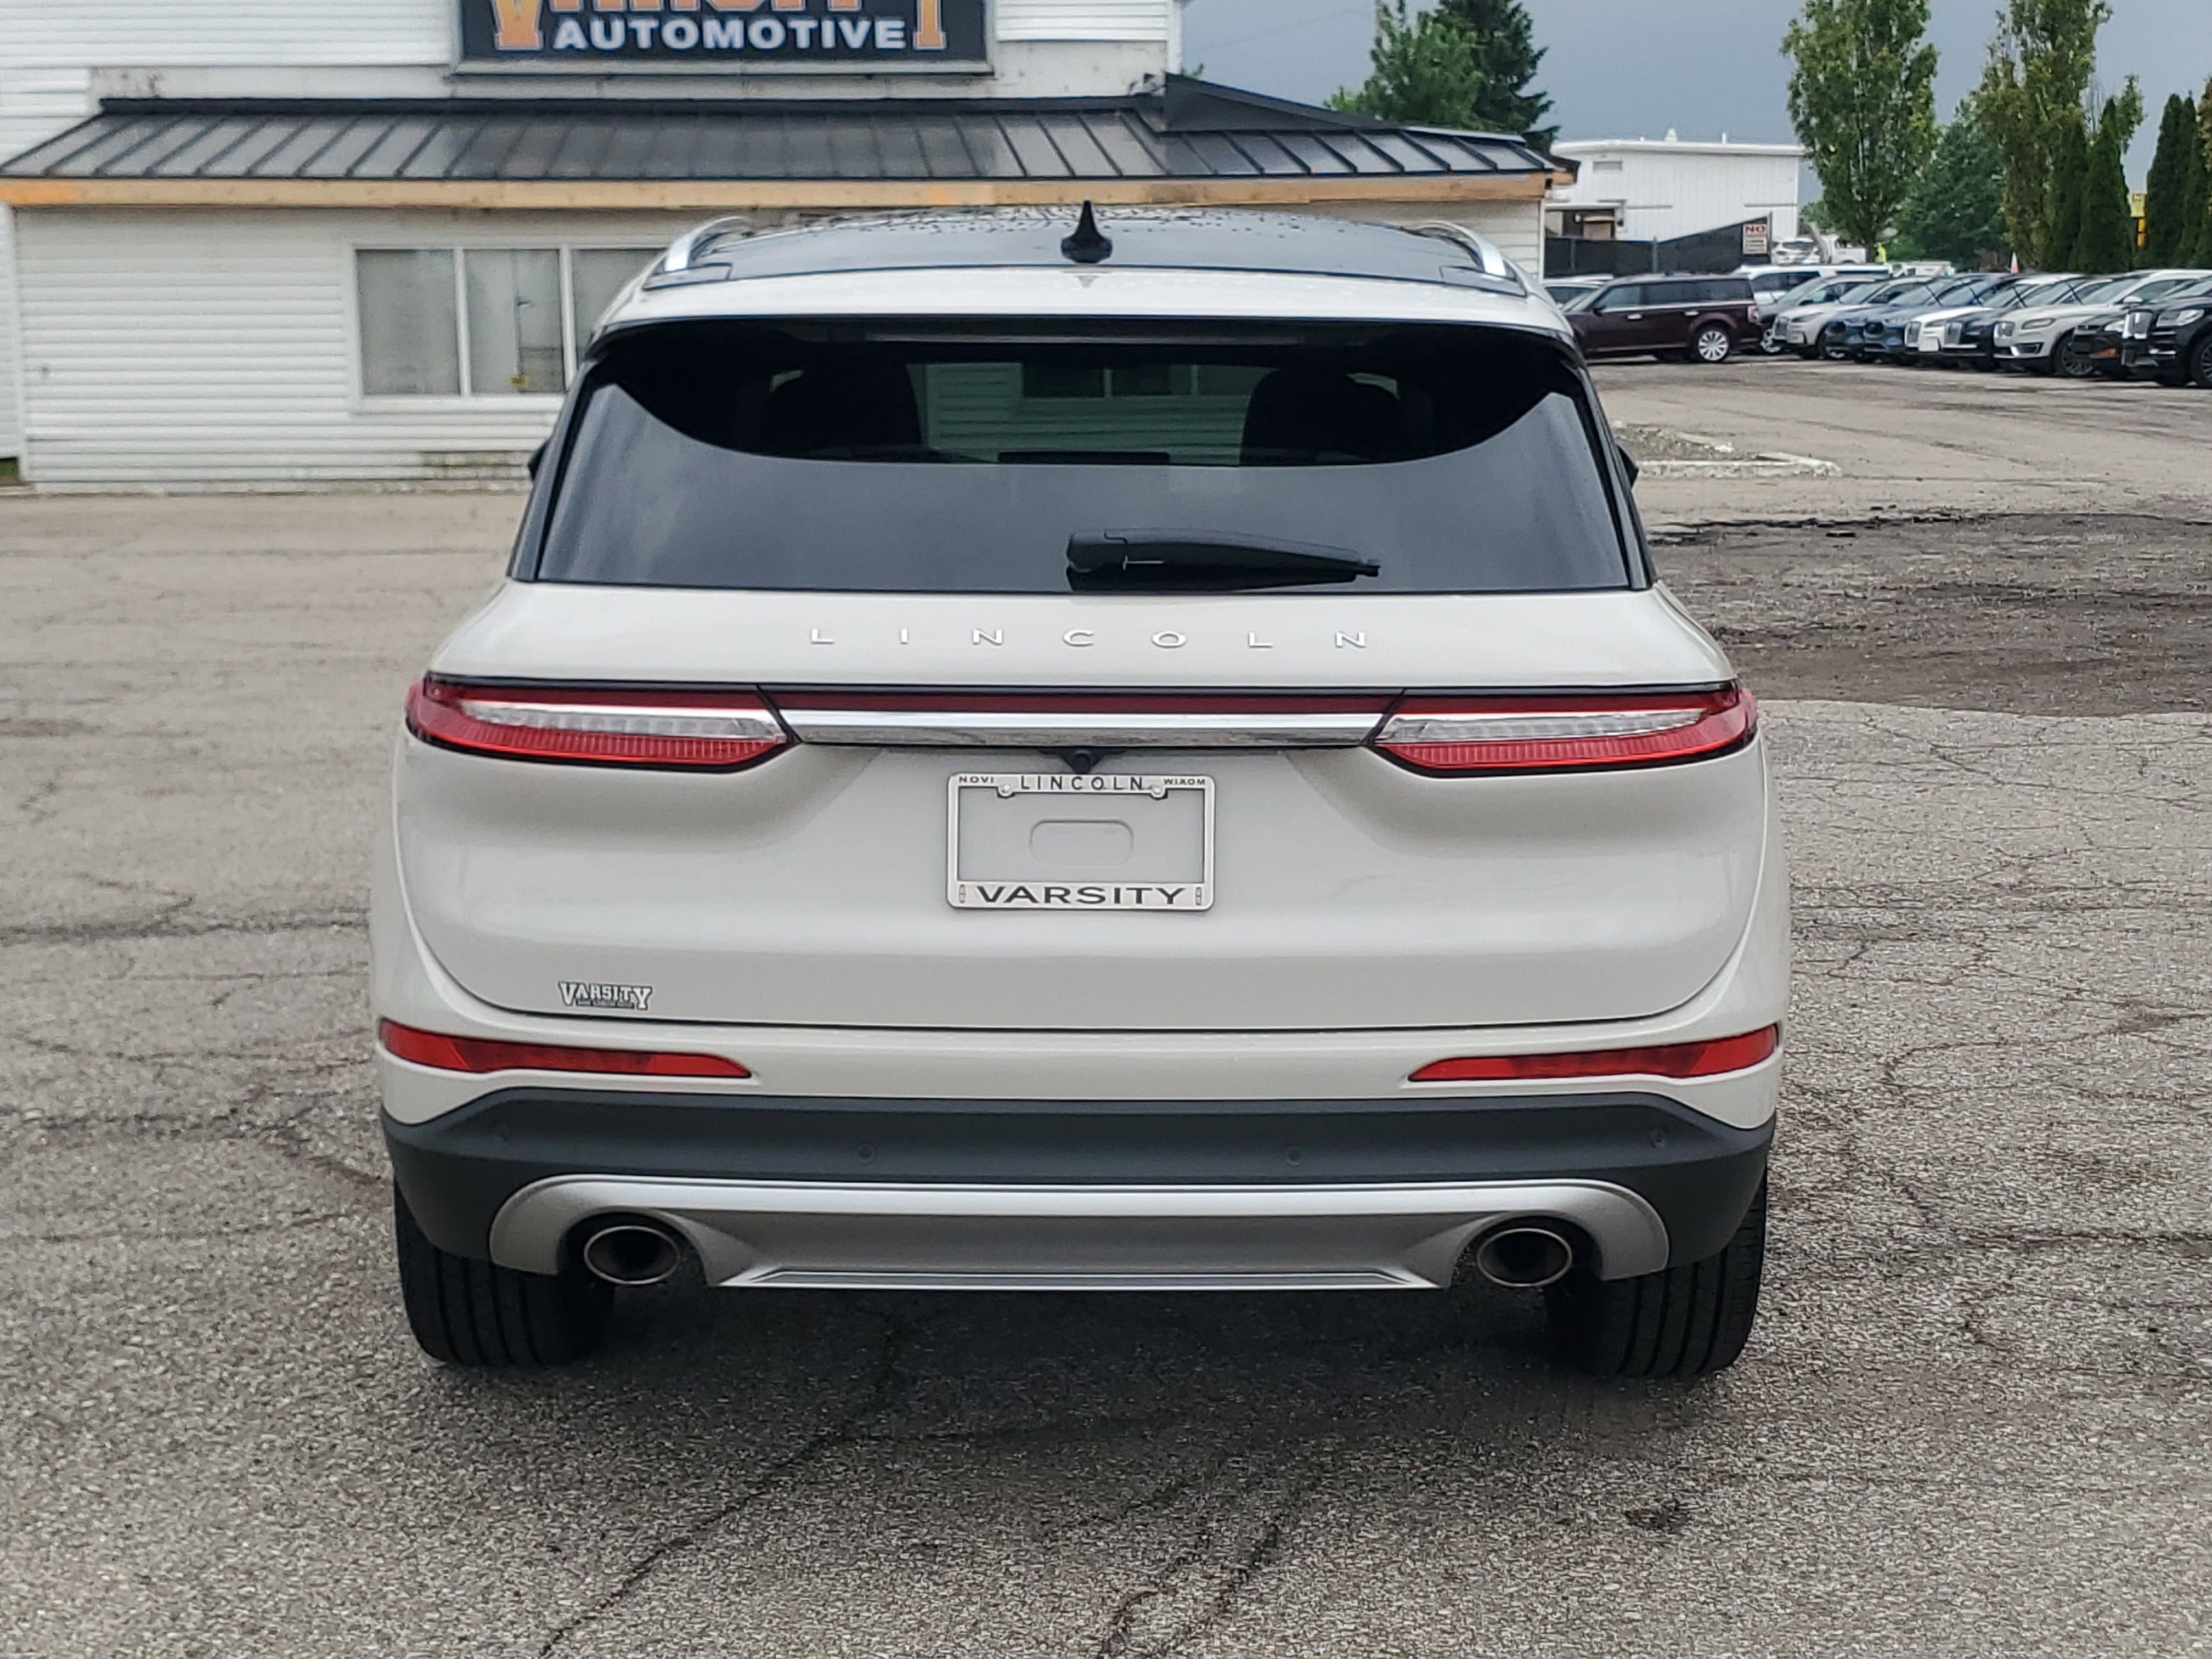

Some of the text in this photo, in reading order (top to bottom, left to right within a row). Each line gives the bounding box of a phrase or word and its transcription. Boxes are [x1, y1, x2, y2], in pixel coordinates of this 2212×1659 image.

[552, 17, 907, 49] AUTOMOTIVE
[1745, 225, 1766, 233] NO
[810, 628, 1368, 650] LINCOLN
[1020, 775, 1143, 791] LINCOLN
[977, 885, 1186, 905] VARSITY
[558, 981, 652, 1010] VARSITY
